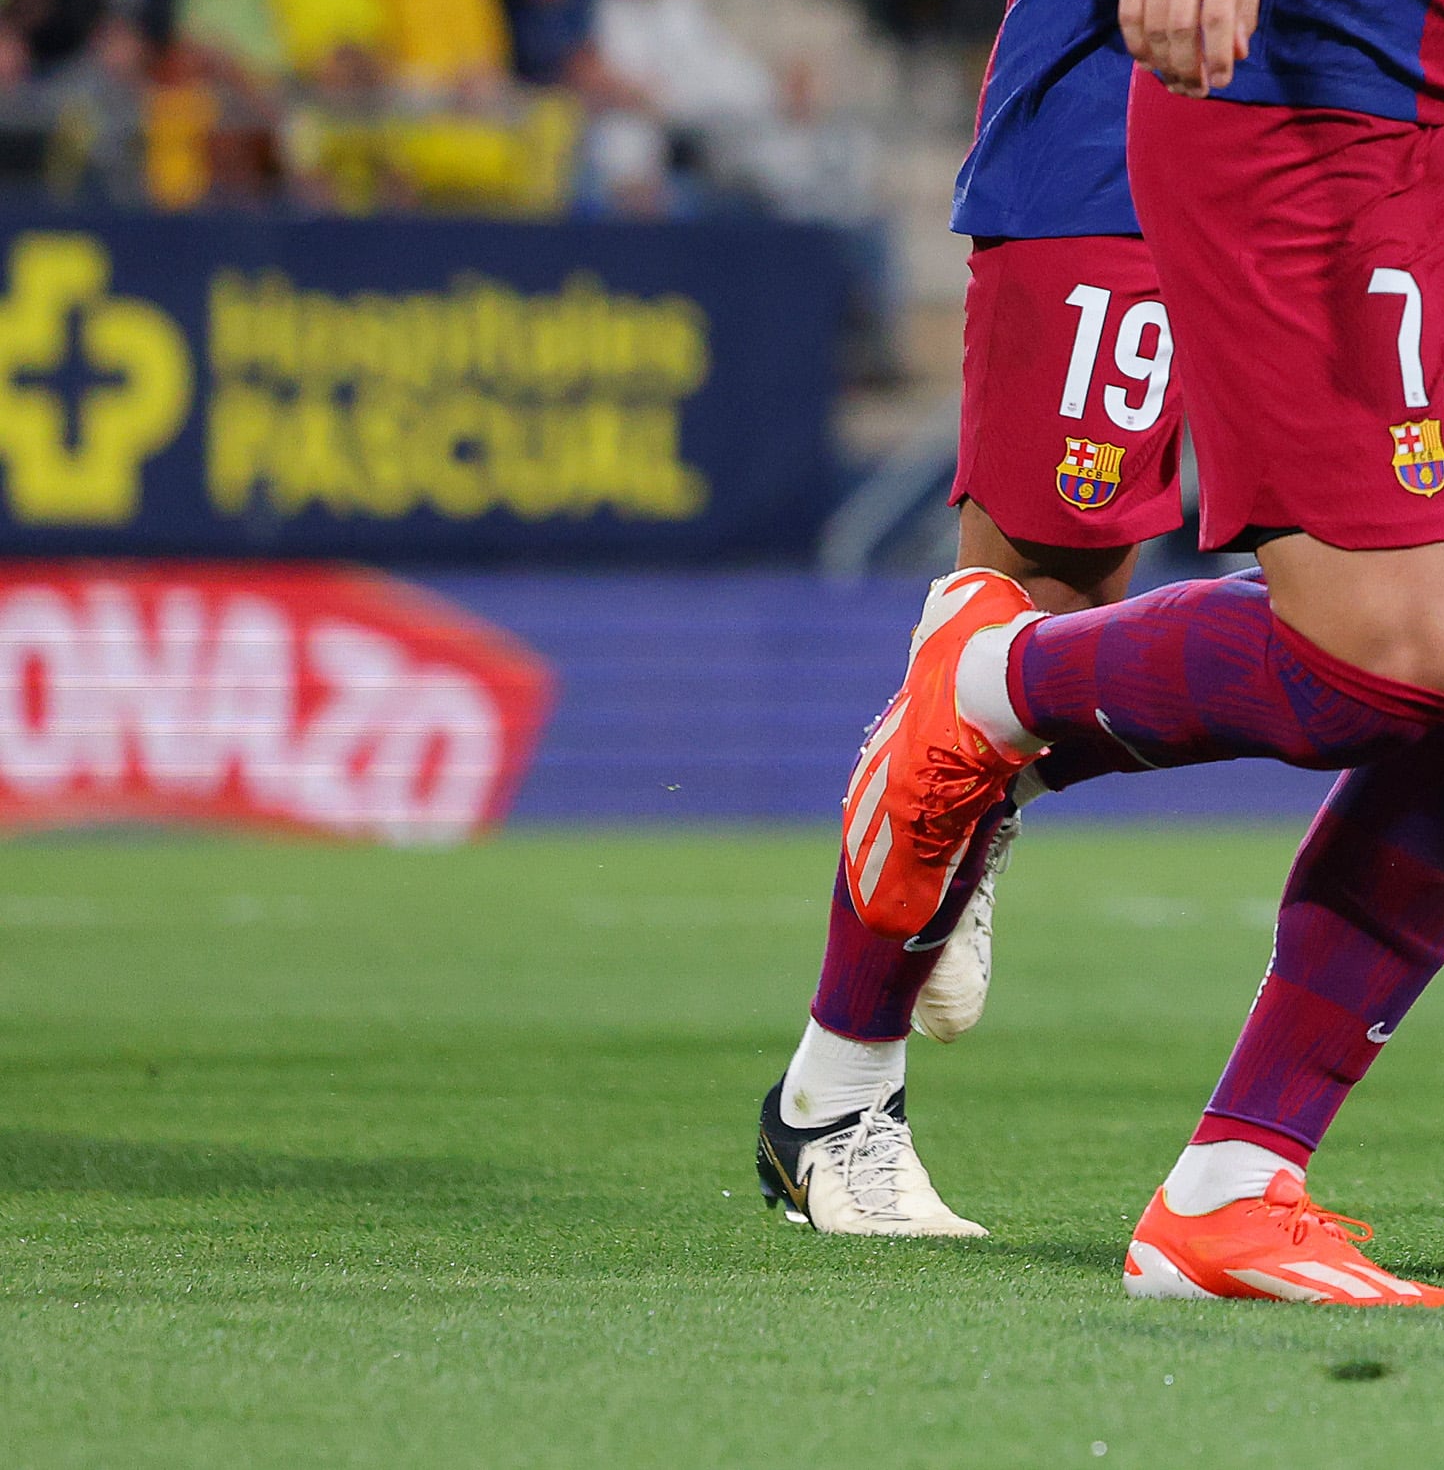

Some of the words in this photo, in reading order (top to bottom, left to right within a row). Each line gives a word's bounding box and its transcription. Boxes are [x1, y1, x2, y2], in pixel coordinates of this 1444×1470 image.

[1059, 283, 1175, 432] 19
[1367, 267, 1430, 408] 7
[1077, 467, 1103, 479] FCB
